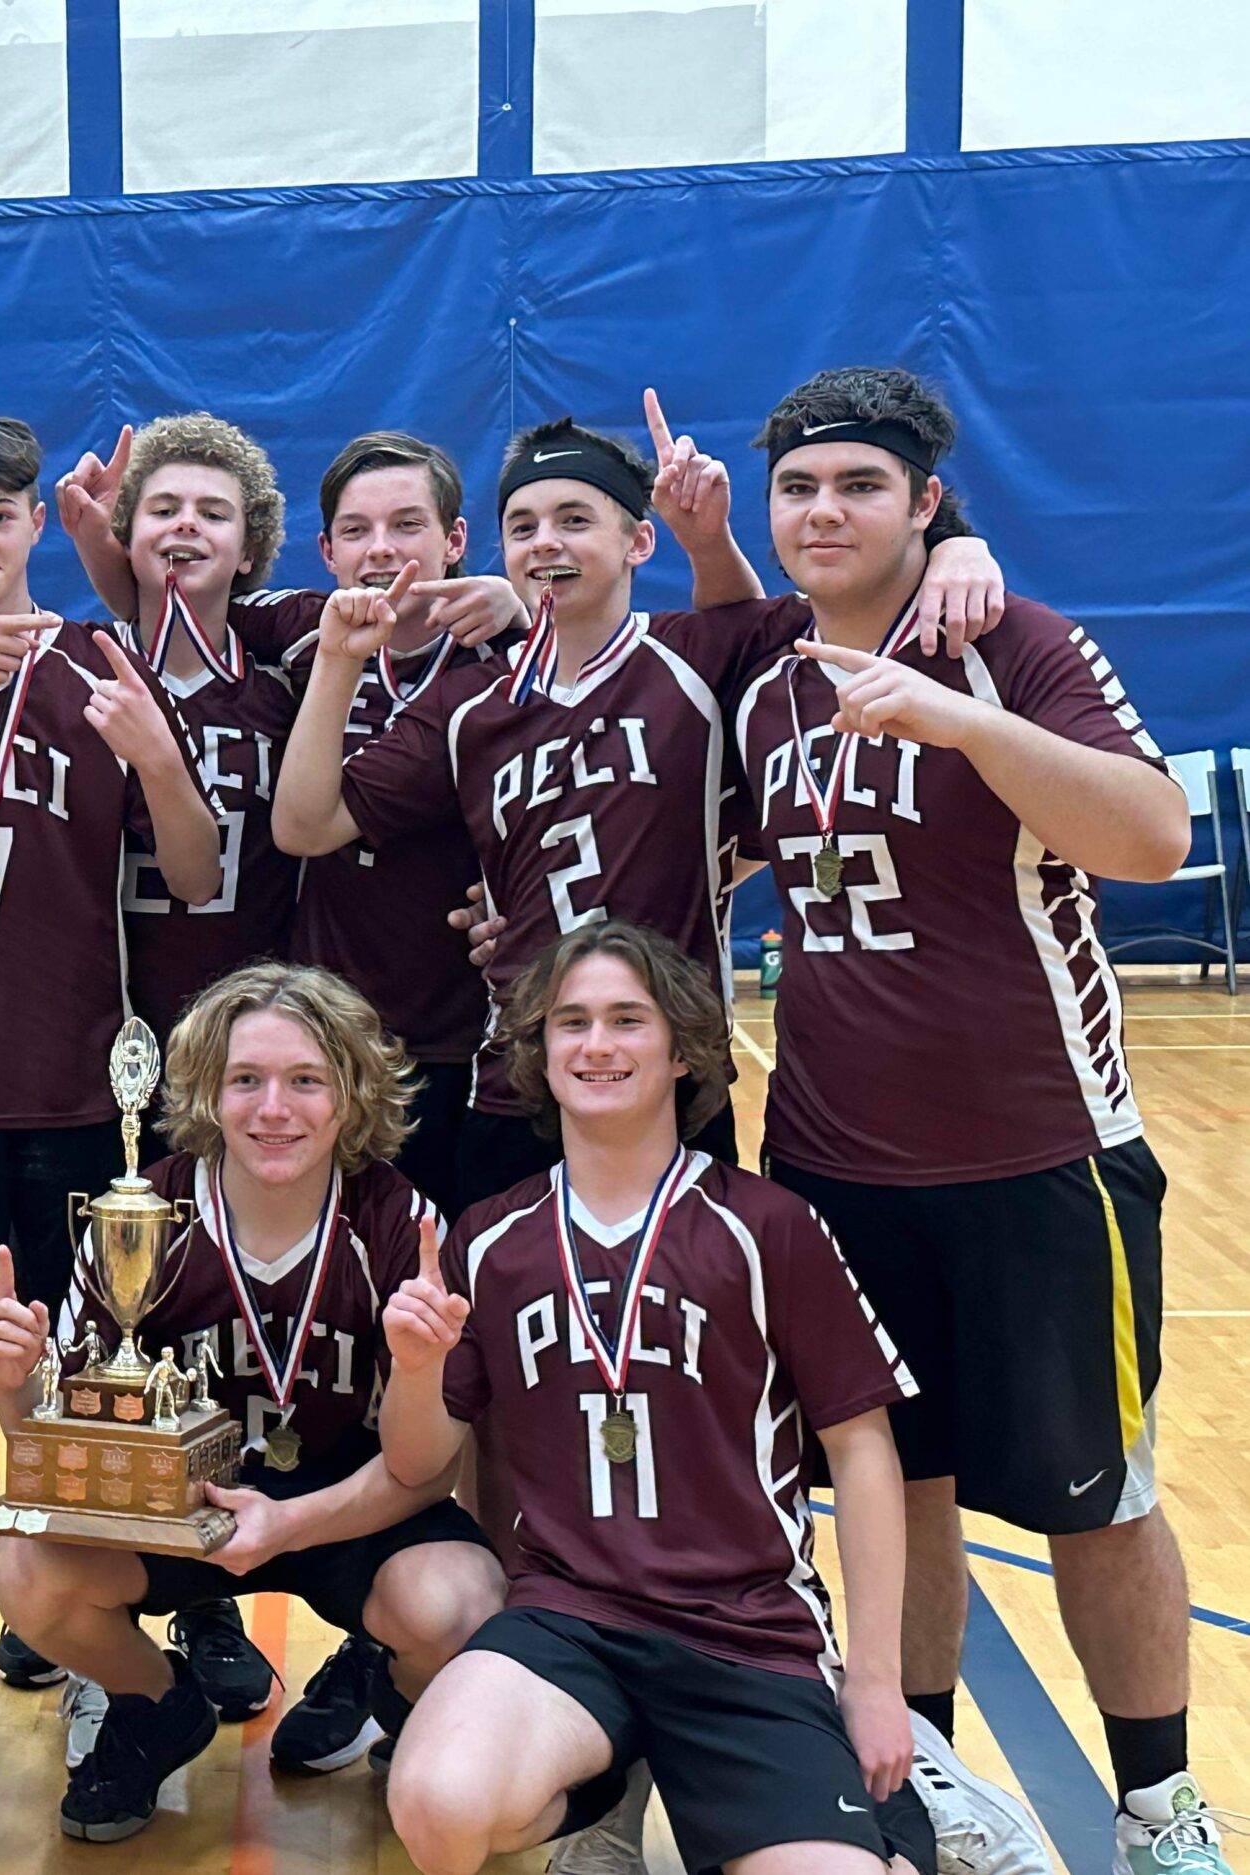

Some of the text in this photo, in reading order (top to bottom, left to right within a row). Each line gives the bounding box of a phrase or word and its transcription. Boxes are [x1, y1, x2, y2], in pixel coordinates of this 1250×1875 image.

[493, 717, 658, 841] PECI
[761, 724, 922, 831] PECI
[540, 813, 608, 935] 2
[778, 834, 916, 952] 22
[765, 951, 780, 966] G
[516, 1279, 708, 1390] PECI
[579, 1393, 659, 1519] 11
